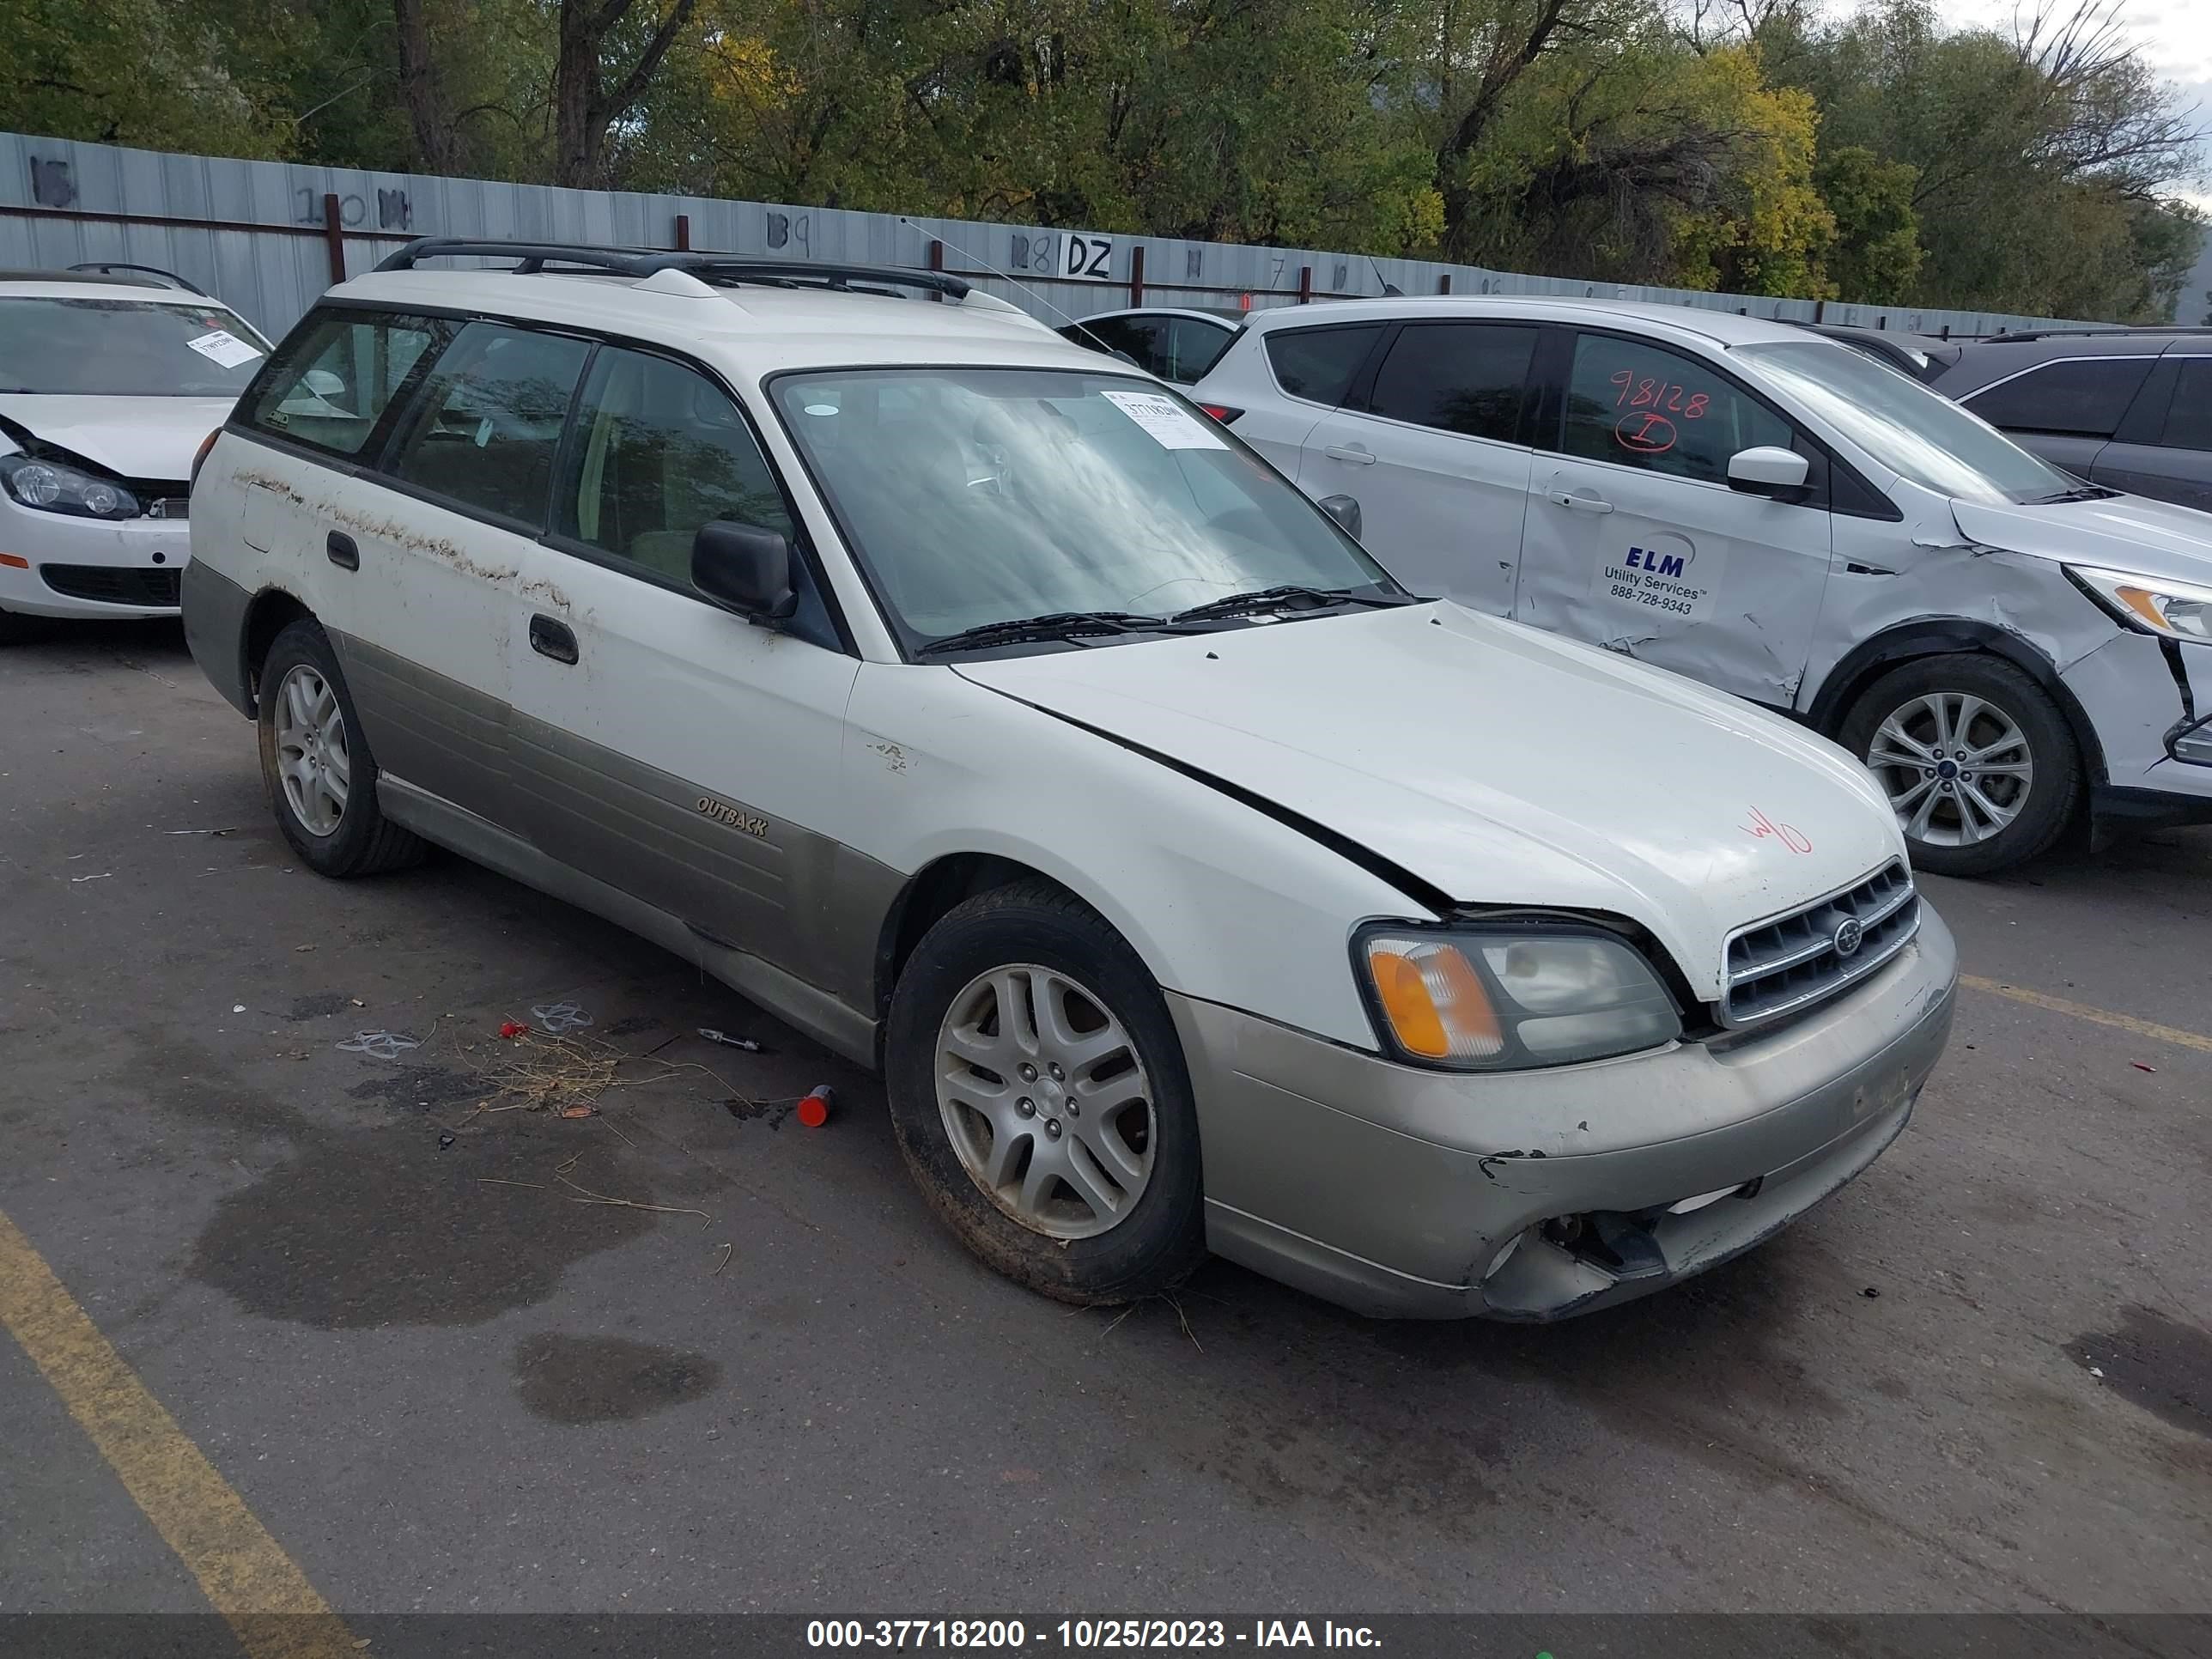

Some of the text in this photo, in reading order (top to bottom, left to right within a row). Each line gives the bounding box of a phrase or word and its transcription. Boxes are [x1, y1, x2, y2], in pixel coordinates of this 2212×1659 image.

[1067, 234, 1112, 279] DZ
[1610, 370, 1710, 419] 98128
[1604, 565, 1642, 589] Utility
[1625, 546, 1685, 579] ELM
[1610, 584, 1692, 616] 888-728-9343
[696, 796, 769, 838] OUTBACK
